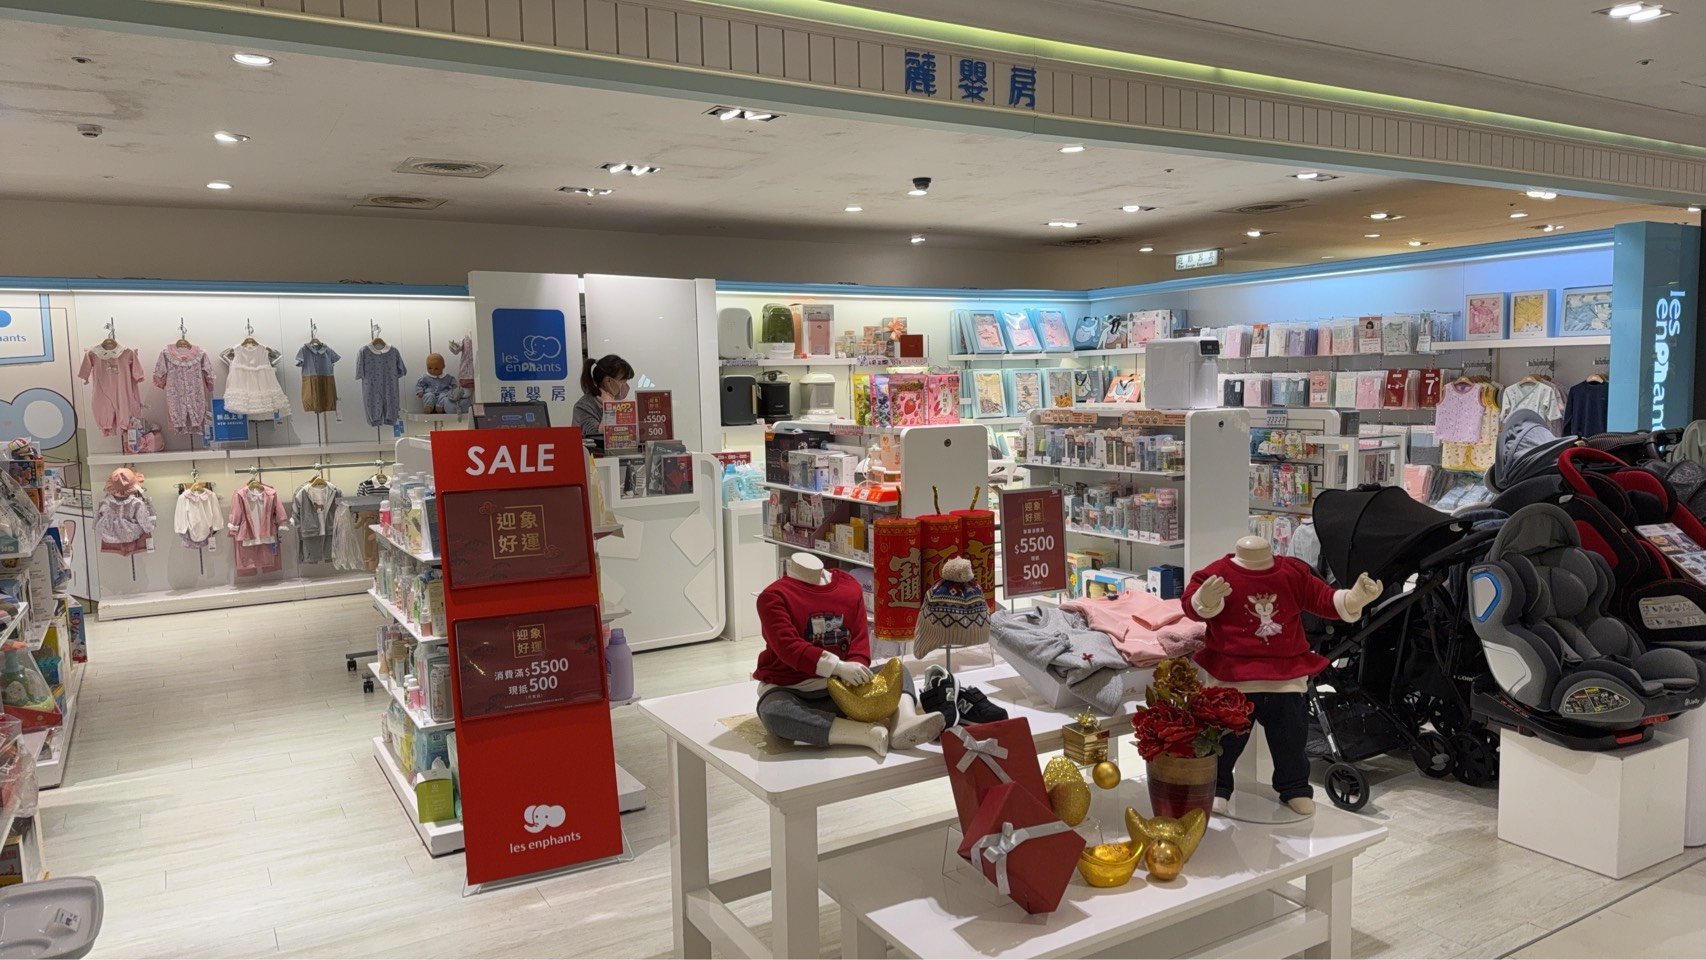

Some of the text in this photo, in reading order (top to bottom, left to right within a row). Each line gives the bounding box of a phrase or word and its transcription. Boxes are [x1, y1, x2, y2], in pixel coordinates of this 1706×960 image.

[905, 51, 1037, 108] 麗嬰房
[1668, 290, 1686, 337] les
[0, 334, 27, 342] ants
[501, 352, 519, 364] les
[501, 385, 566, 403] 麗嬰房
[648, 427, 663, 436] 500
[465, 443, 555, 476] SALE
[497, 510, 539, 531] 迎象
[498, 533, 541, 553] 好運
[1014, 535, 1055, 555] $5500
[1023, 562, 1049, 580] 500
[516, 627, 542, 641] 迎象
[517, 640, 543, 654] 好運
[509, 832, 582, 854] les enphants
